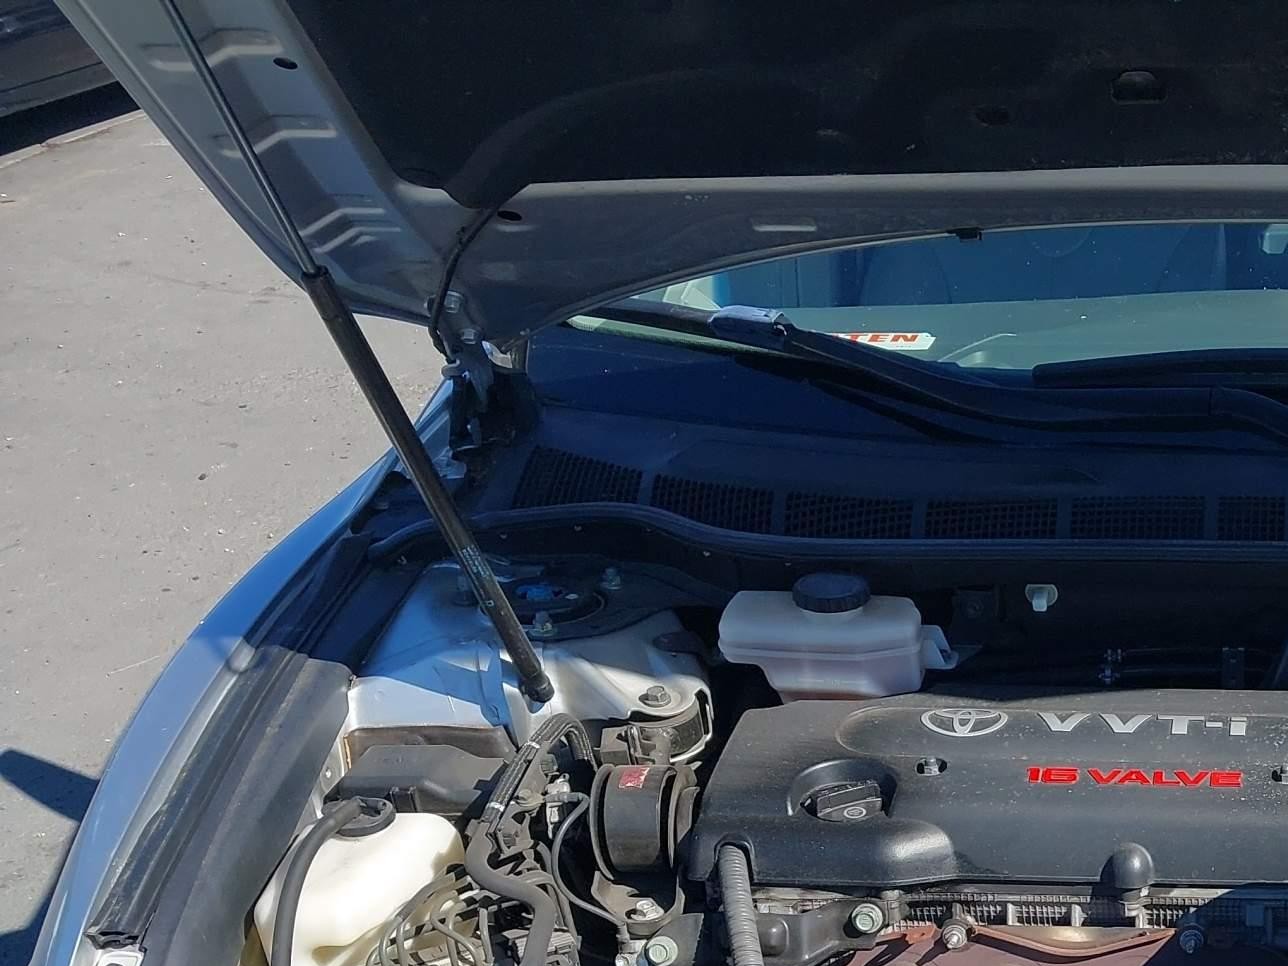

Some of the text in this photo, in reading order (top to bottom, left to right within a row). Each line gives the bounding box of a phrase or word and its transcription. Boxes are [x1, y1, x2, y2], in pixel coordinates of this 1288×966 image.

[1036, 711, 1248, 736] VVT-i
[1026, 767, 1244, 788] 16 VALVE
